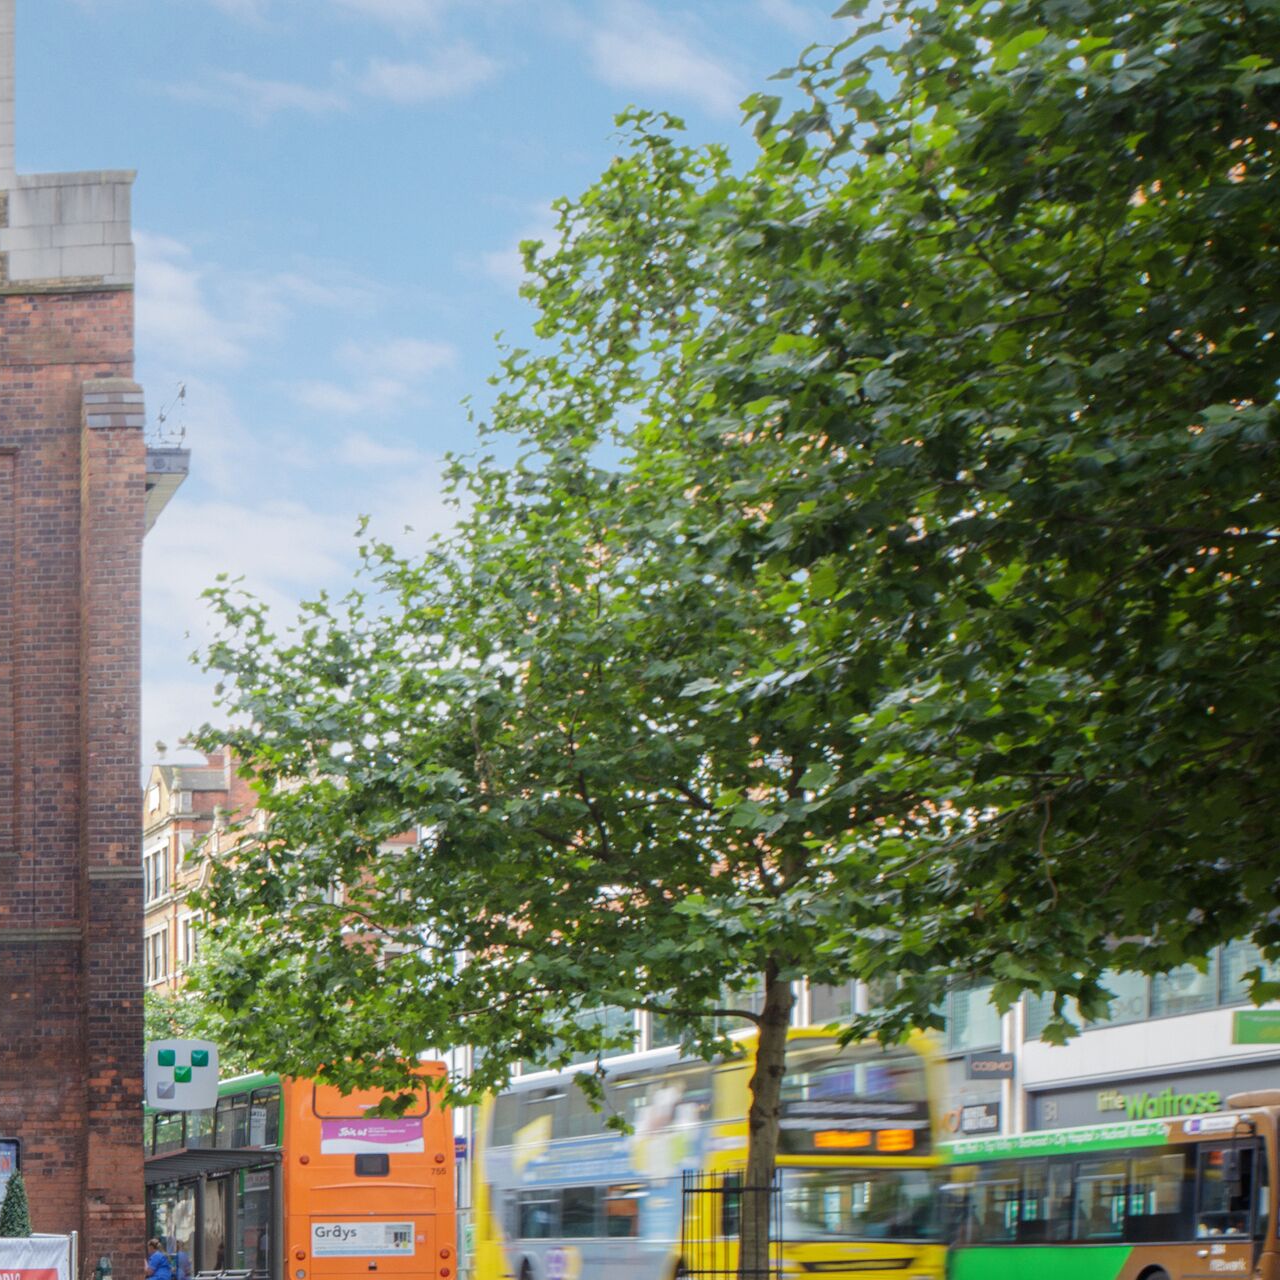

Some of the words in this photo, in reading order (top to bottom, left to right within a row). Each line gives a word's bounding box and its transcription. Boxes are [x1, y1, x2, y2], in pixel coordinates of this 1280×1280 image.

[1096, 1089, 1125, 1112] little
[1124, 1087, 1222, 1119] Waitrose
[315, 1225, 357, 1241] Grays
